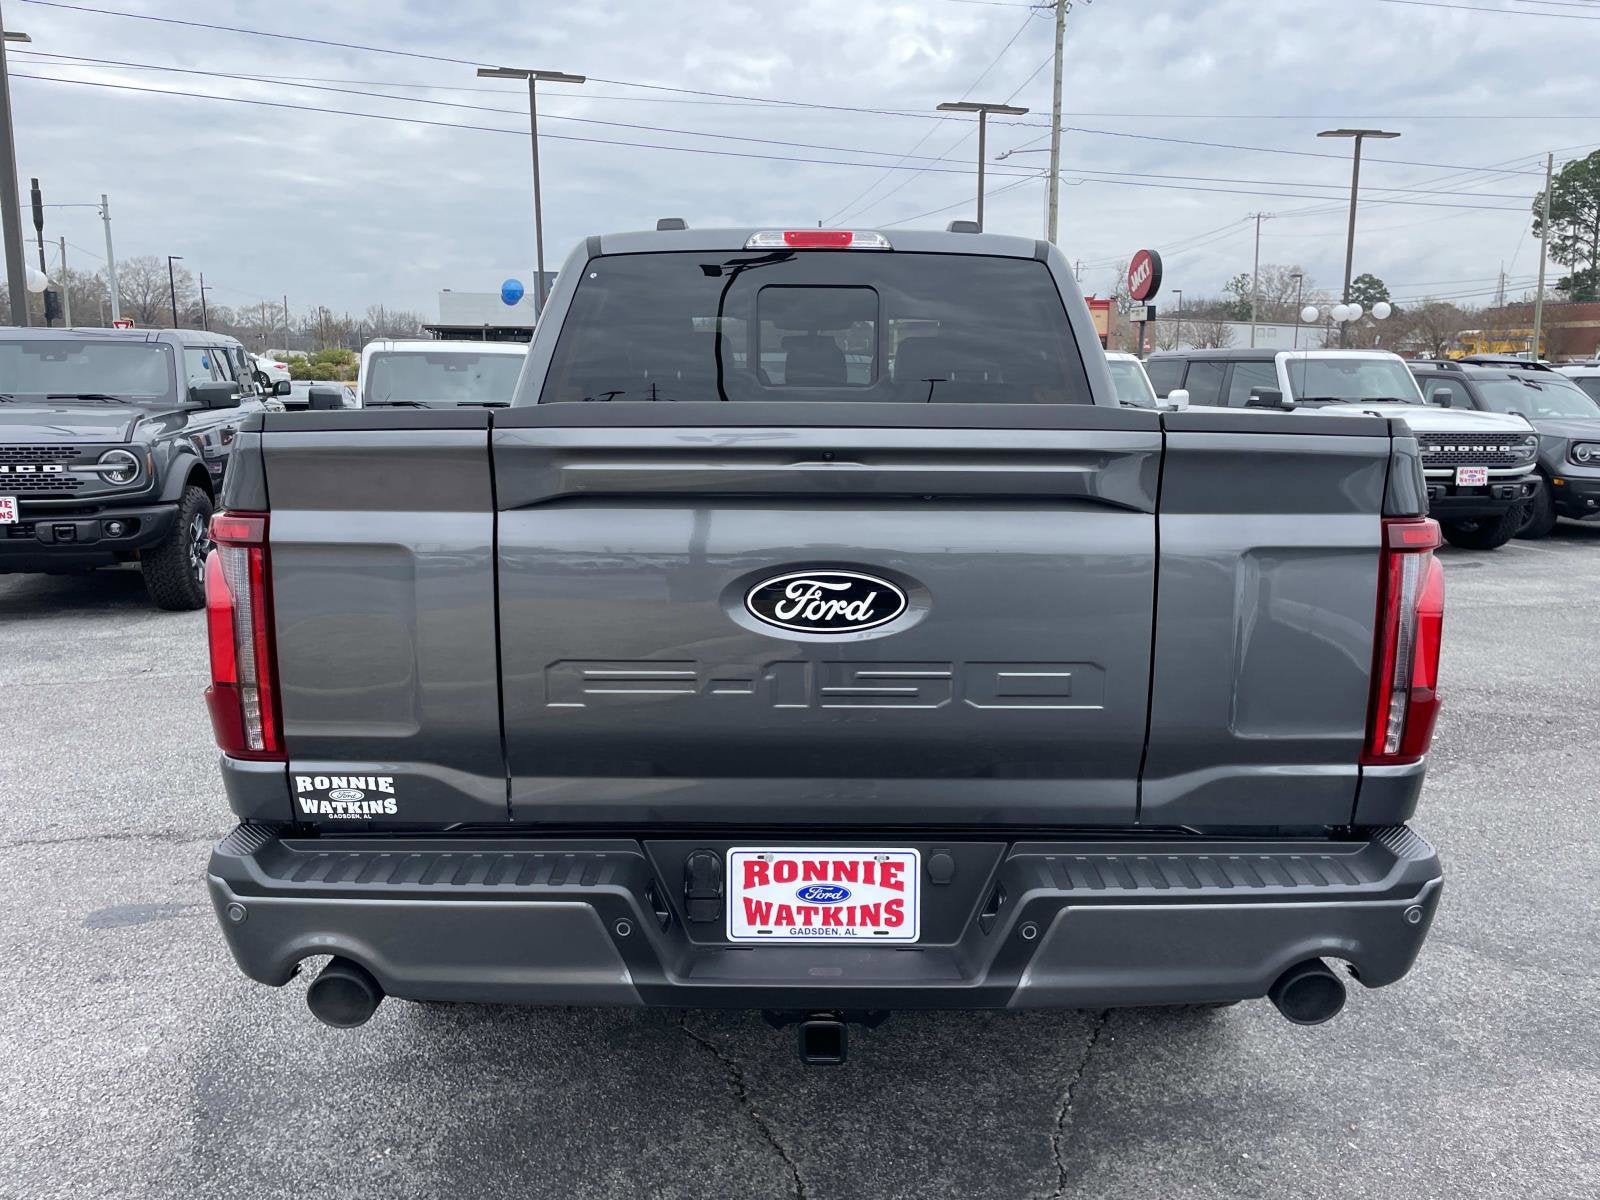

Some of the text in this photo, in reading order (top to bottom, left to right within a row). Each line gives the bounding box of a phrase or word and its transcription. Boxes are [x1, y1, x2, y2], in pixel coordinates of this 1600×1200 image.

[775, 580, 877, 621] Ford
[545, 658, 1105, 710] F-150
[295, 776, 395, 794] RONNIE
[298, 796, 398, 814] WATKINS
[743, 860, 905, 892] RONNIE
[804, 886, 844, 900] Ford
[743, 896, 905, 928] WATKINS
[789, 927, 857, 936] GADSDEN, AL
